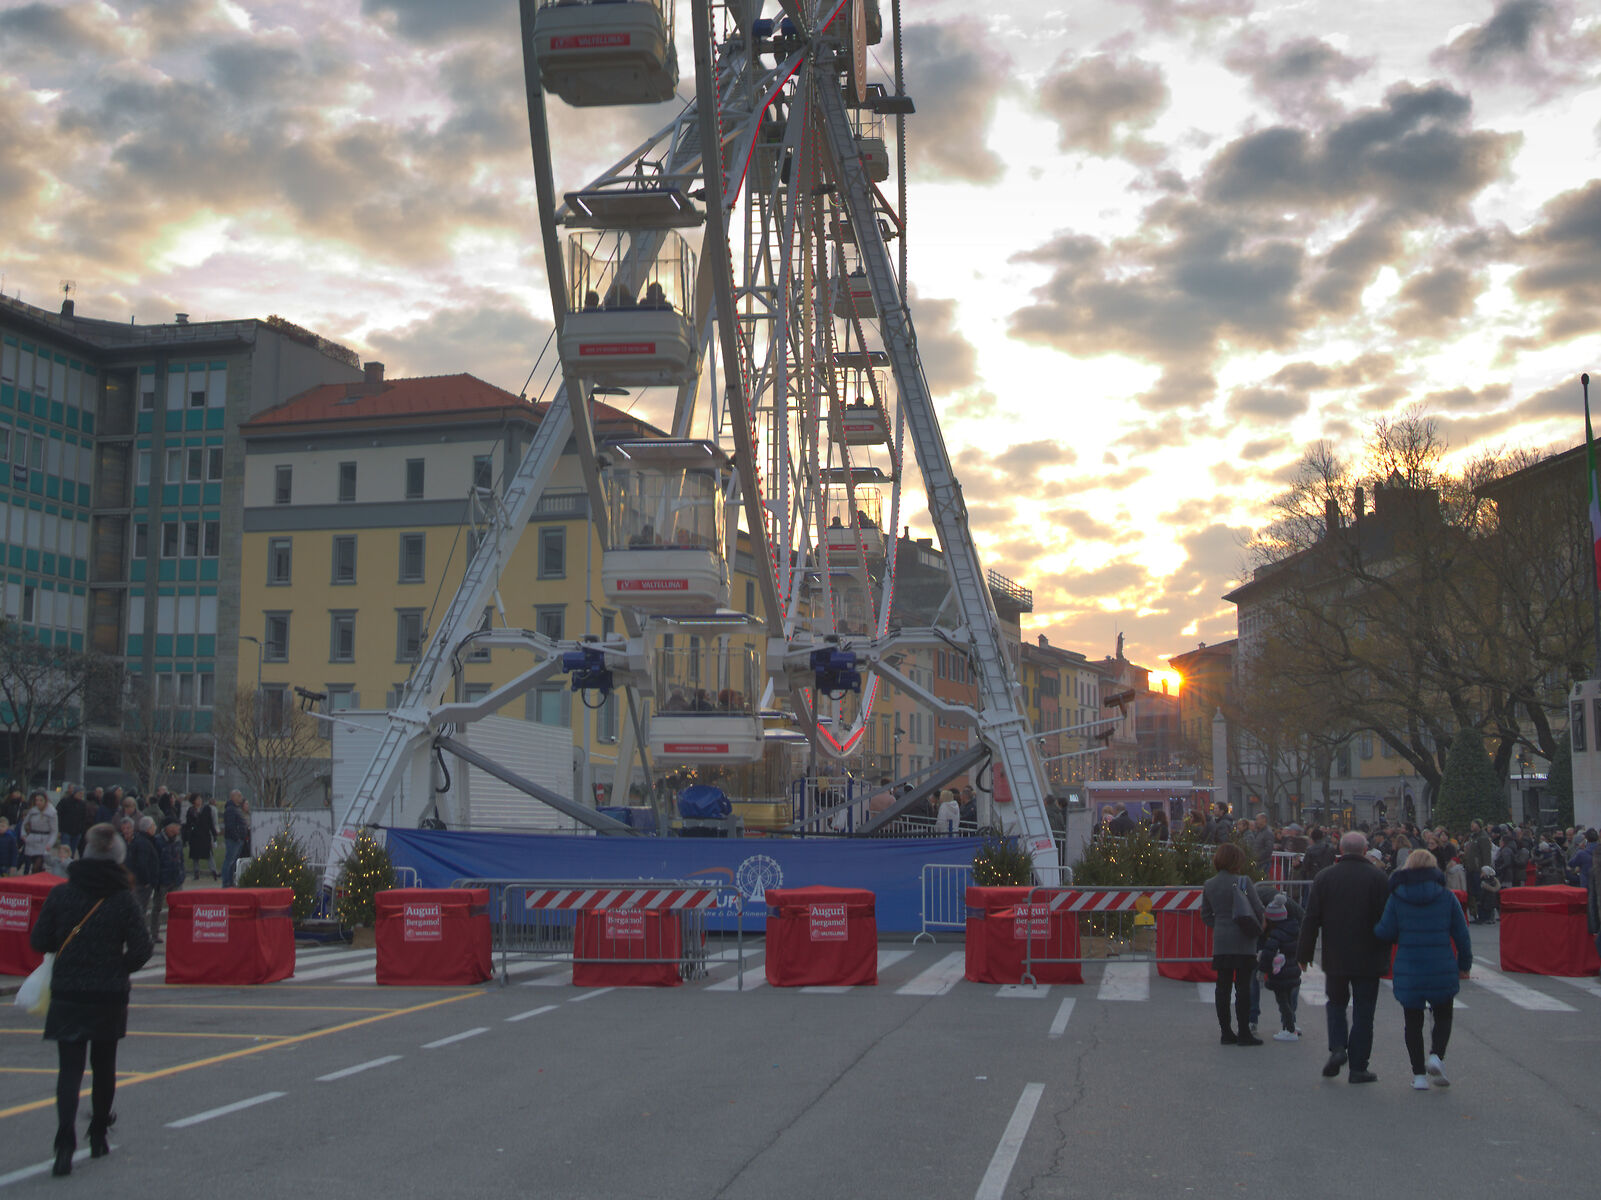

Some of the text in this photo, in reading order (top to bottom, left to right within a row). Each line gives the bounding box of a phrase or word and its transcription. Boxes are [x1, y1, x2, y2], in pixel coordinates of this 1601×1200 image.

[1, 895, 29, 907] Auguri
[195, 907, 226, 919] Auguri
[406, 905, 438, 917] Auguri
[812, 905, 844, 917] Auguri
[812, 918, 845, 928] Bergamo!
